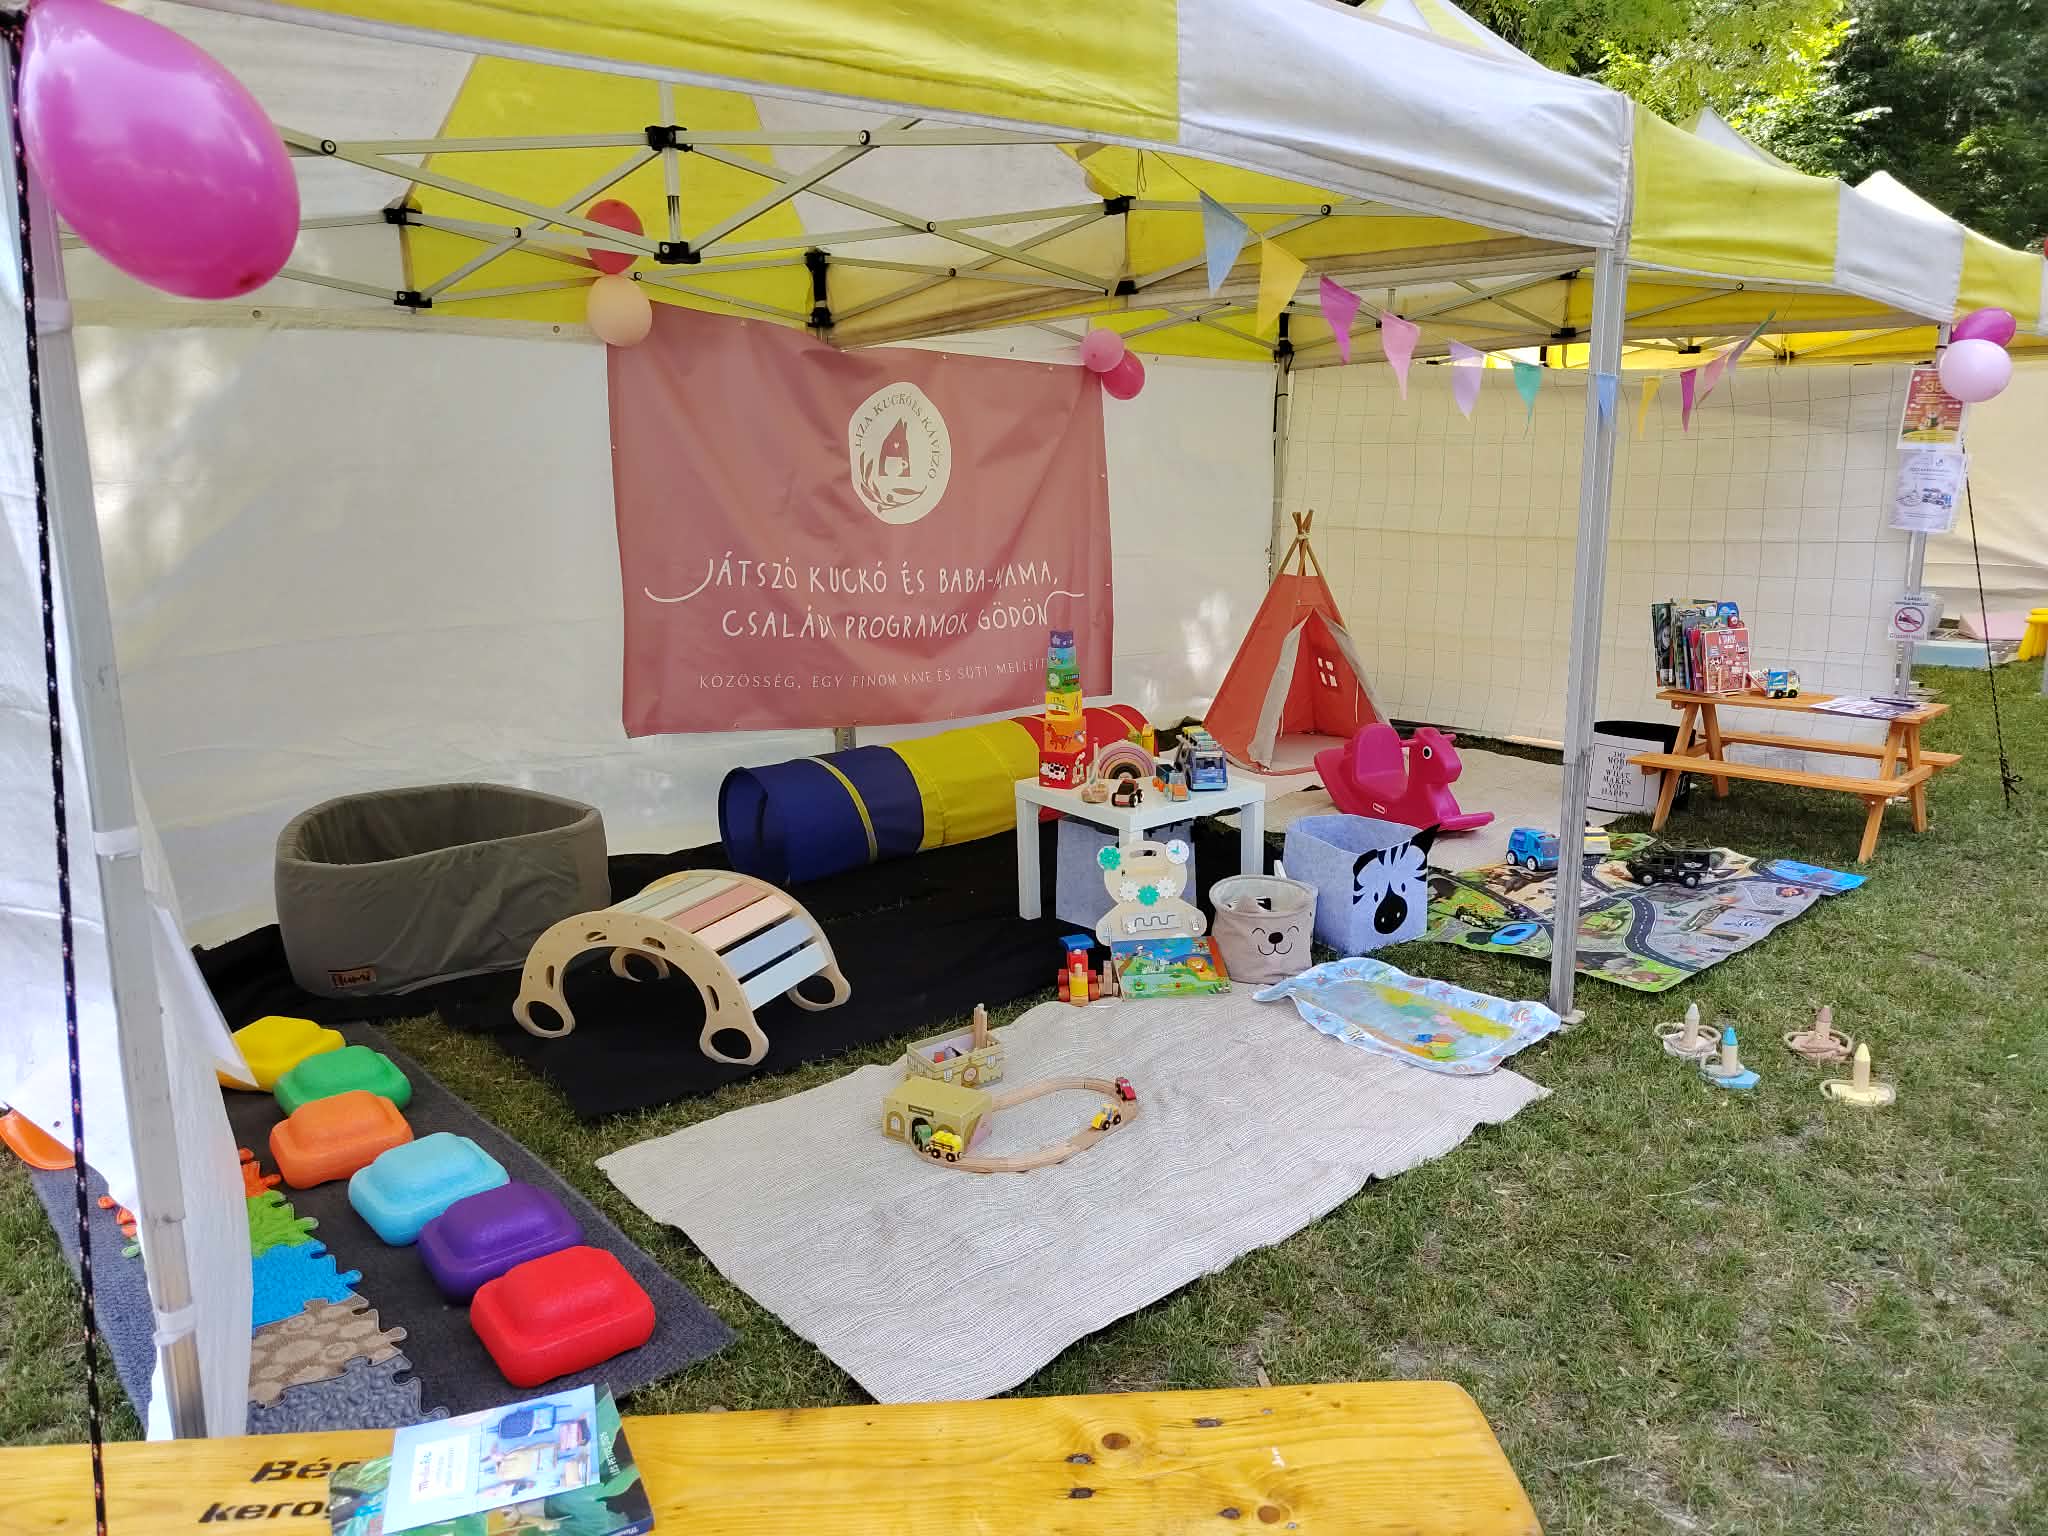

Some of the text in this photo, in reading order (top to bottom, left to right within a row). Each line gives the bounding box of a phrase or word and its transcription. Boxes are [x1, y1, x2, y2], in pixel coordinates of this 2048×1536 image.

[855, 416, 873, 448] LIZA
[678, 551, 798, 601] JÁTSZÓ
[809, 561, 887, 594] KUCKÓ
[901, 561, 925, 595] ÉS
[845, 612, 968, 640] PROGRAMOK
[978, 592, 1060, 631] GÖDÖN
[812, 674, 843, 688] EGY
[852, 672, 898, 688] FINOM
[1603, 775, 1632, 785] MAKES
[1601, 787, 1630, 799] HAPPY
